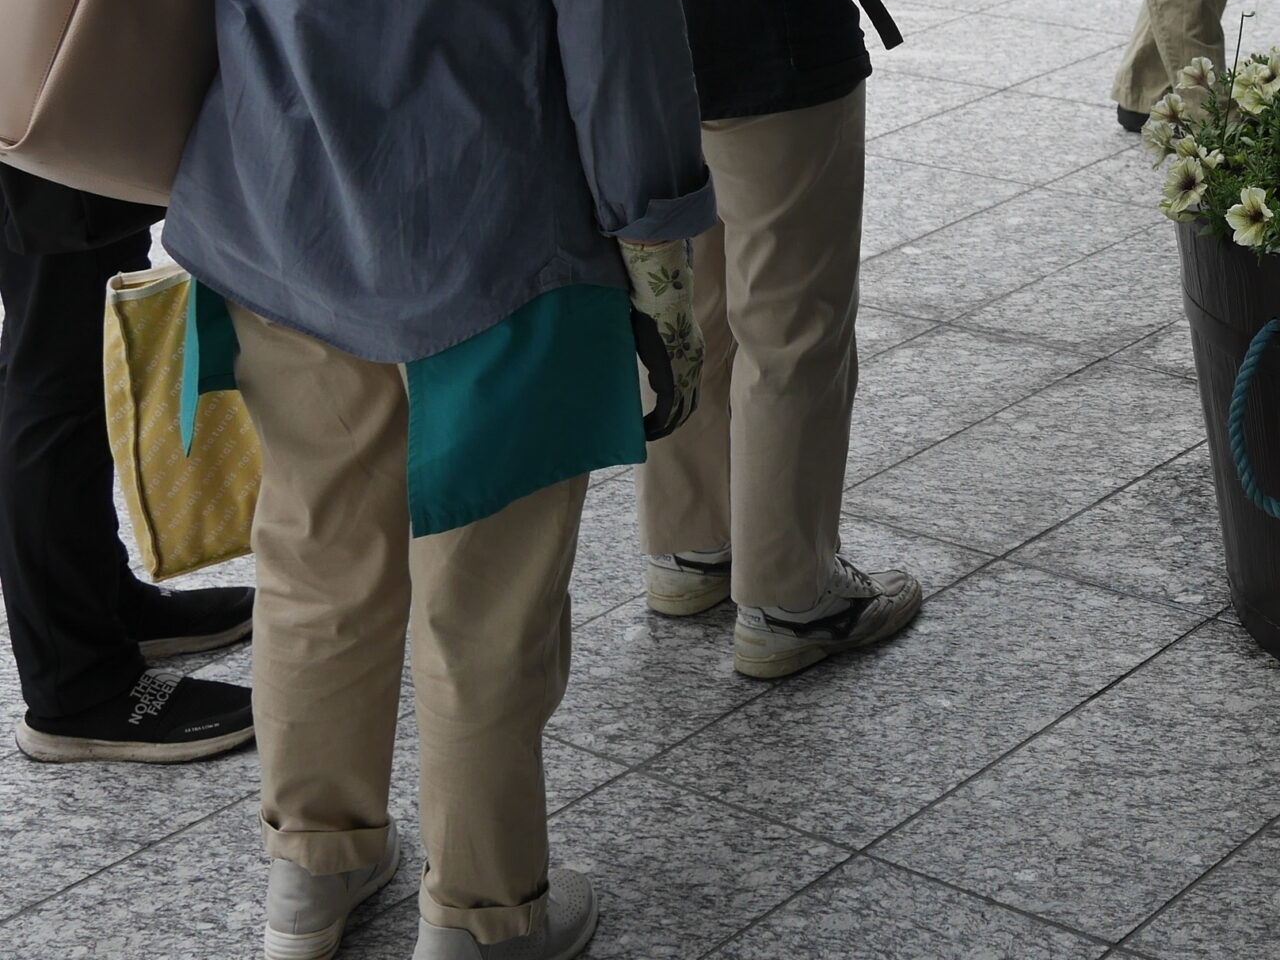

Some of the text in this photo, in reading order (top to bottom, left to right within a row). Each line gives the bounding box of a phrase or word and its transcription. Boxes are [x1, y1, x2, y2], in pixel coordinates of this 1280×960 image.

[128, 680, 164, 725] NORTH
[129, 674, 153, 698] THE
[146, 683, 174, 716] FACE
